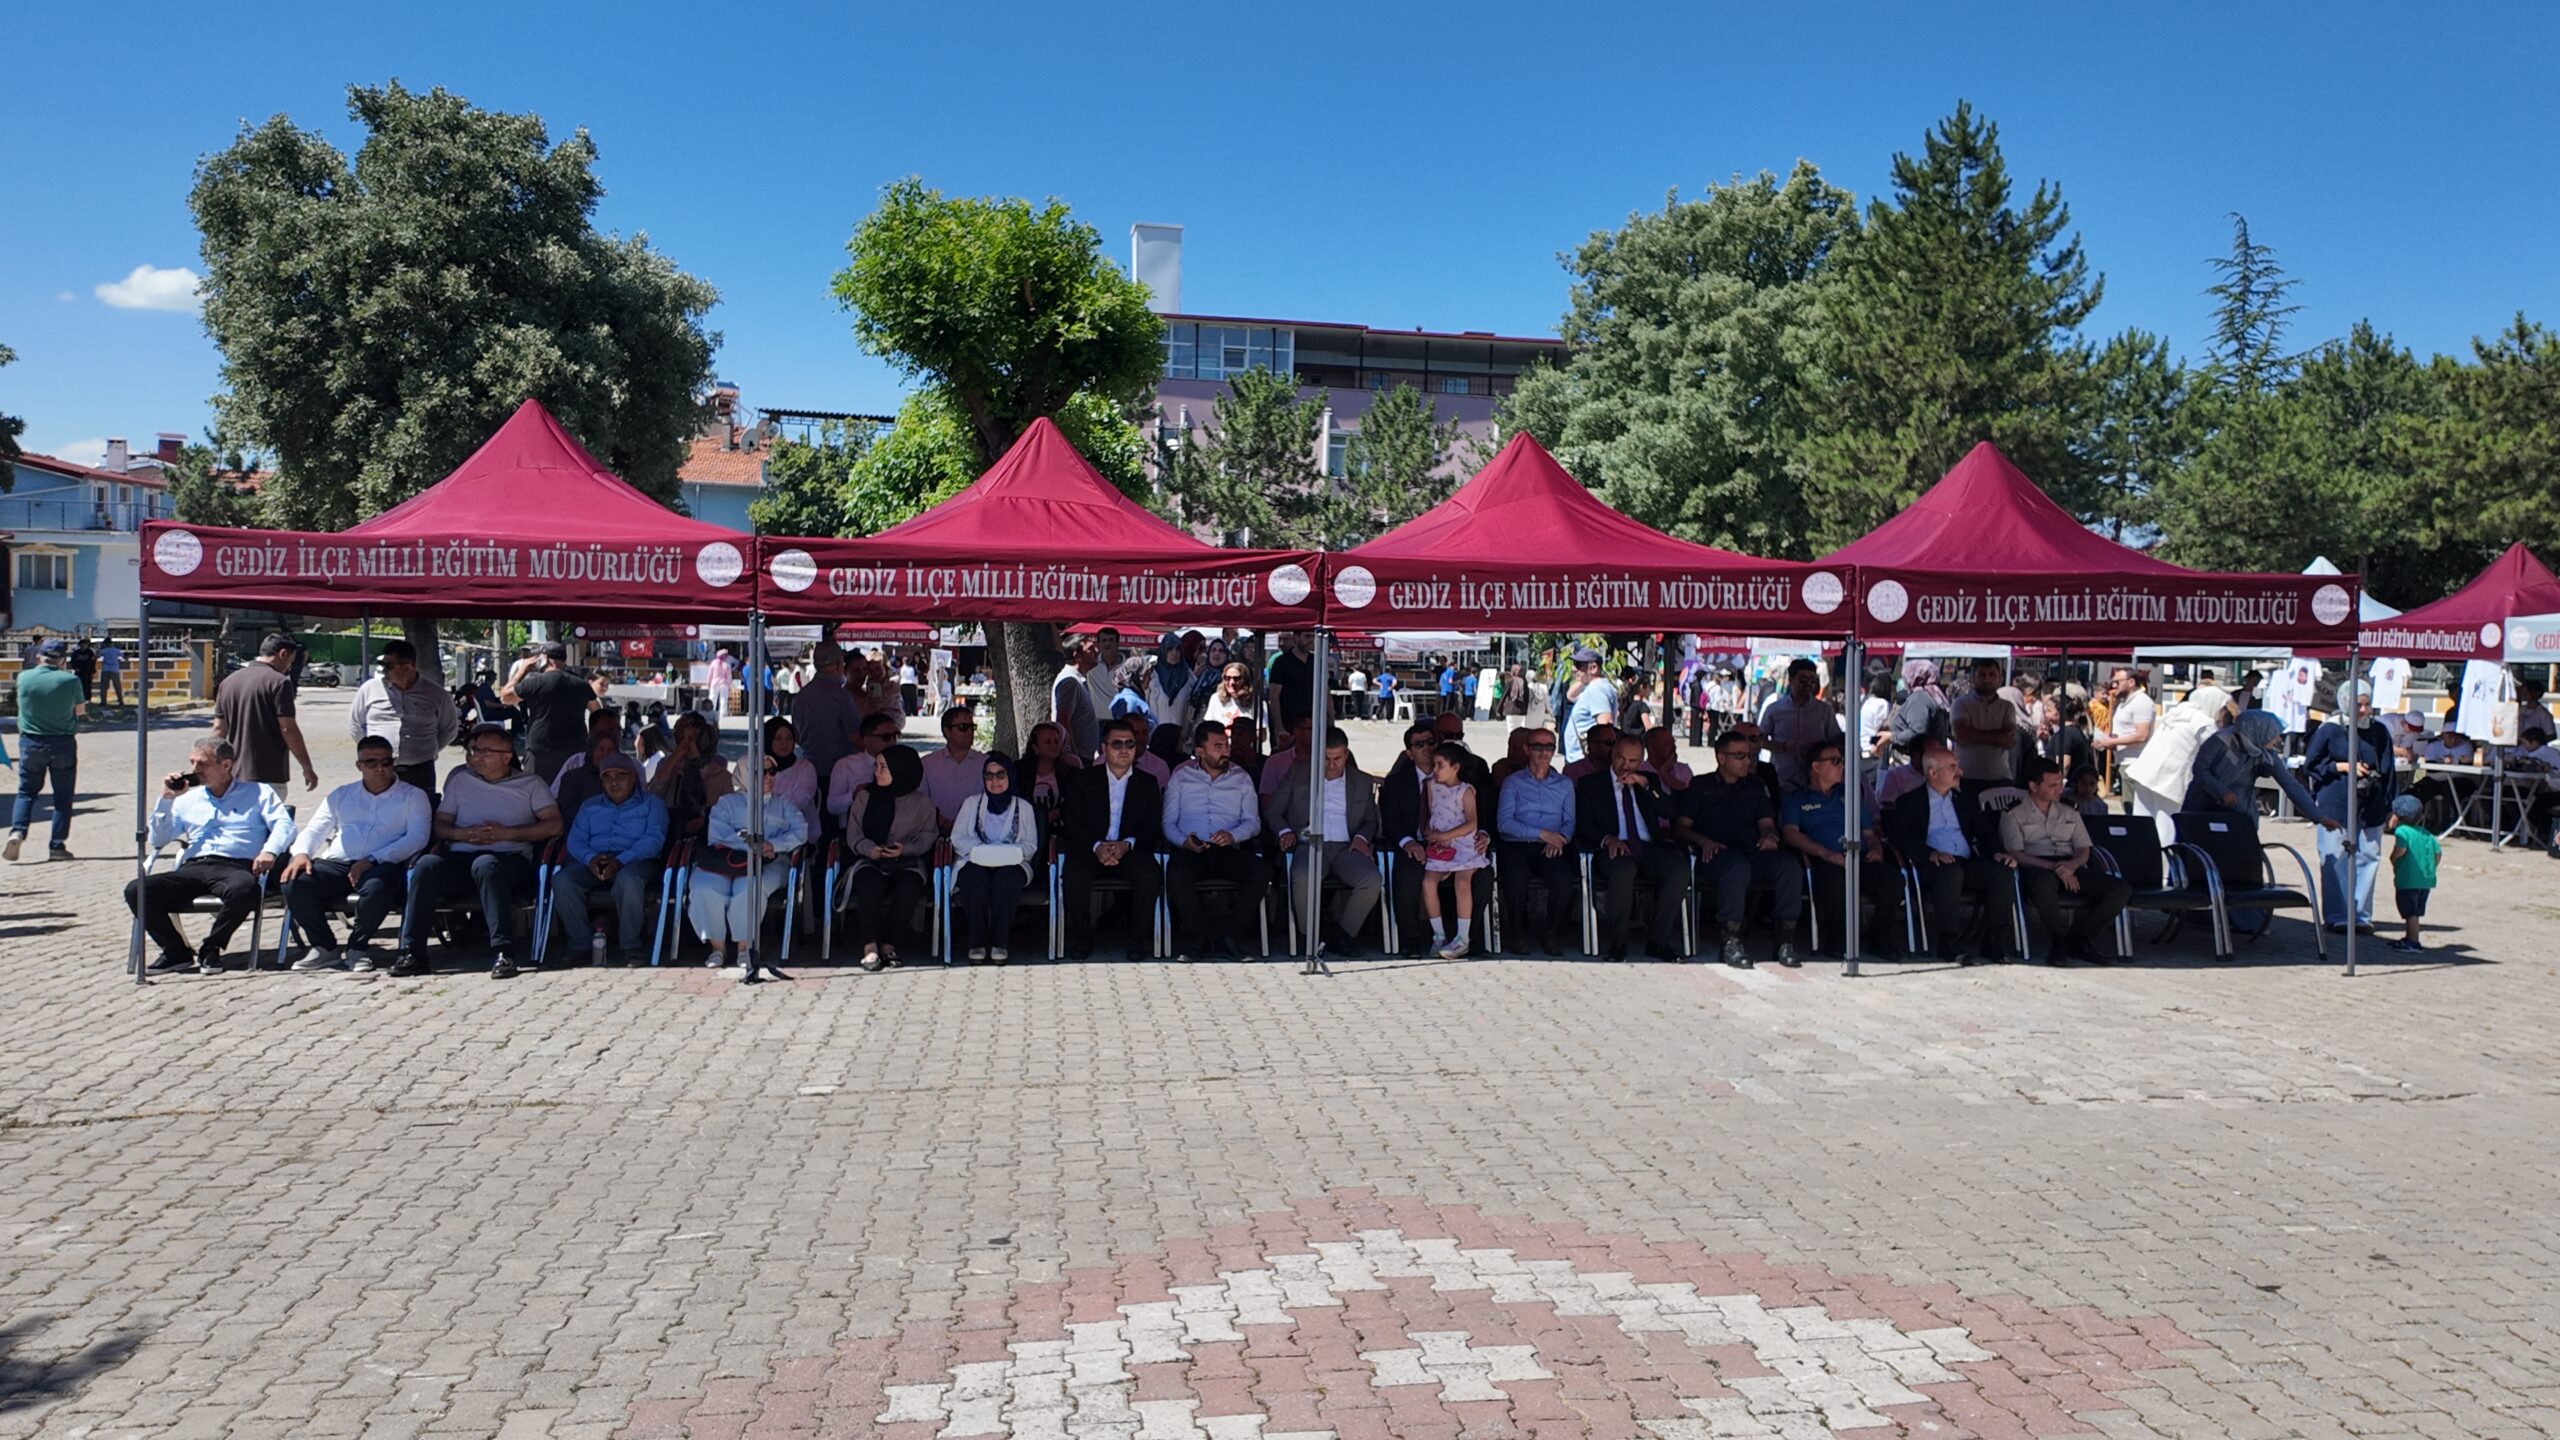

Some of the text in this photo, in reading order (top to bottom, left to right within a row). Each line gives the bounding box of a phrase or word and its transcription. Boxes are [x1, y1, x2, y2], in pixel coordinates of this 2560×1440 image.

[216, 538, 683, 585] GEDİZ İLÇE MİLLİ EĞİTİM MÜDÜRLÜĞÜ
[829, 561, 1257, 607] GEDİZ İLÇE MİLLİ EĞİTİM MÜDÜRLÜĞÜ
[1389, 573, 1791, 618] GEDİZ İLÇE MİLLİ EĞİTİM MÜDÜRLÜĞÜ
[1916, 587, 2299, 631] GEDİZ İLÇE MİLLİ EĞİTİM MÜDÜRLÜĞÜ
[2382, 628, 2415, 648] EĞİTİM
[2416, 630, 2477, 652] MÜDÜRLÜĞÜ
